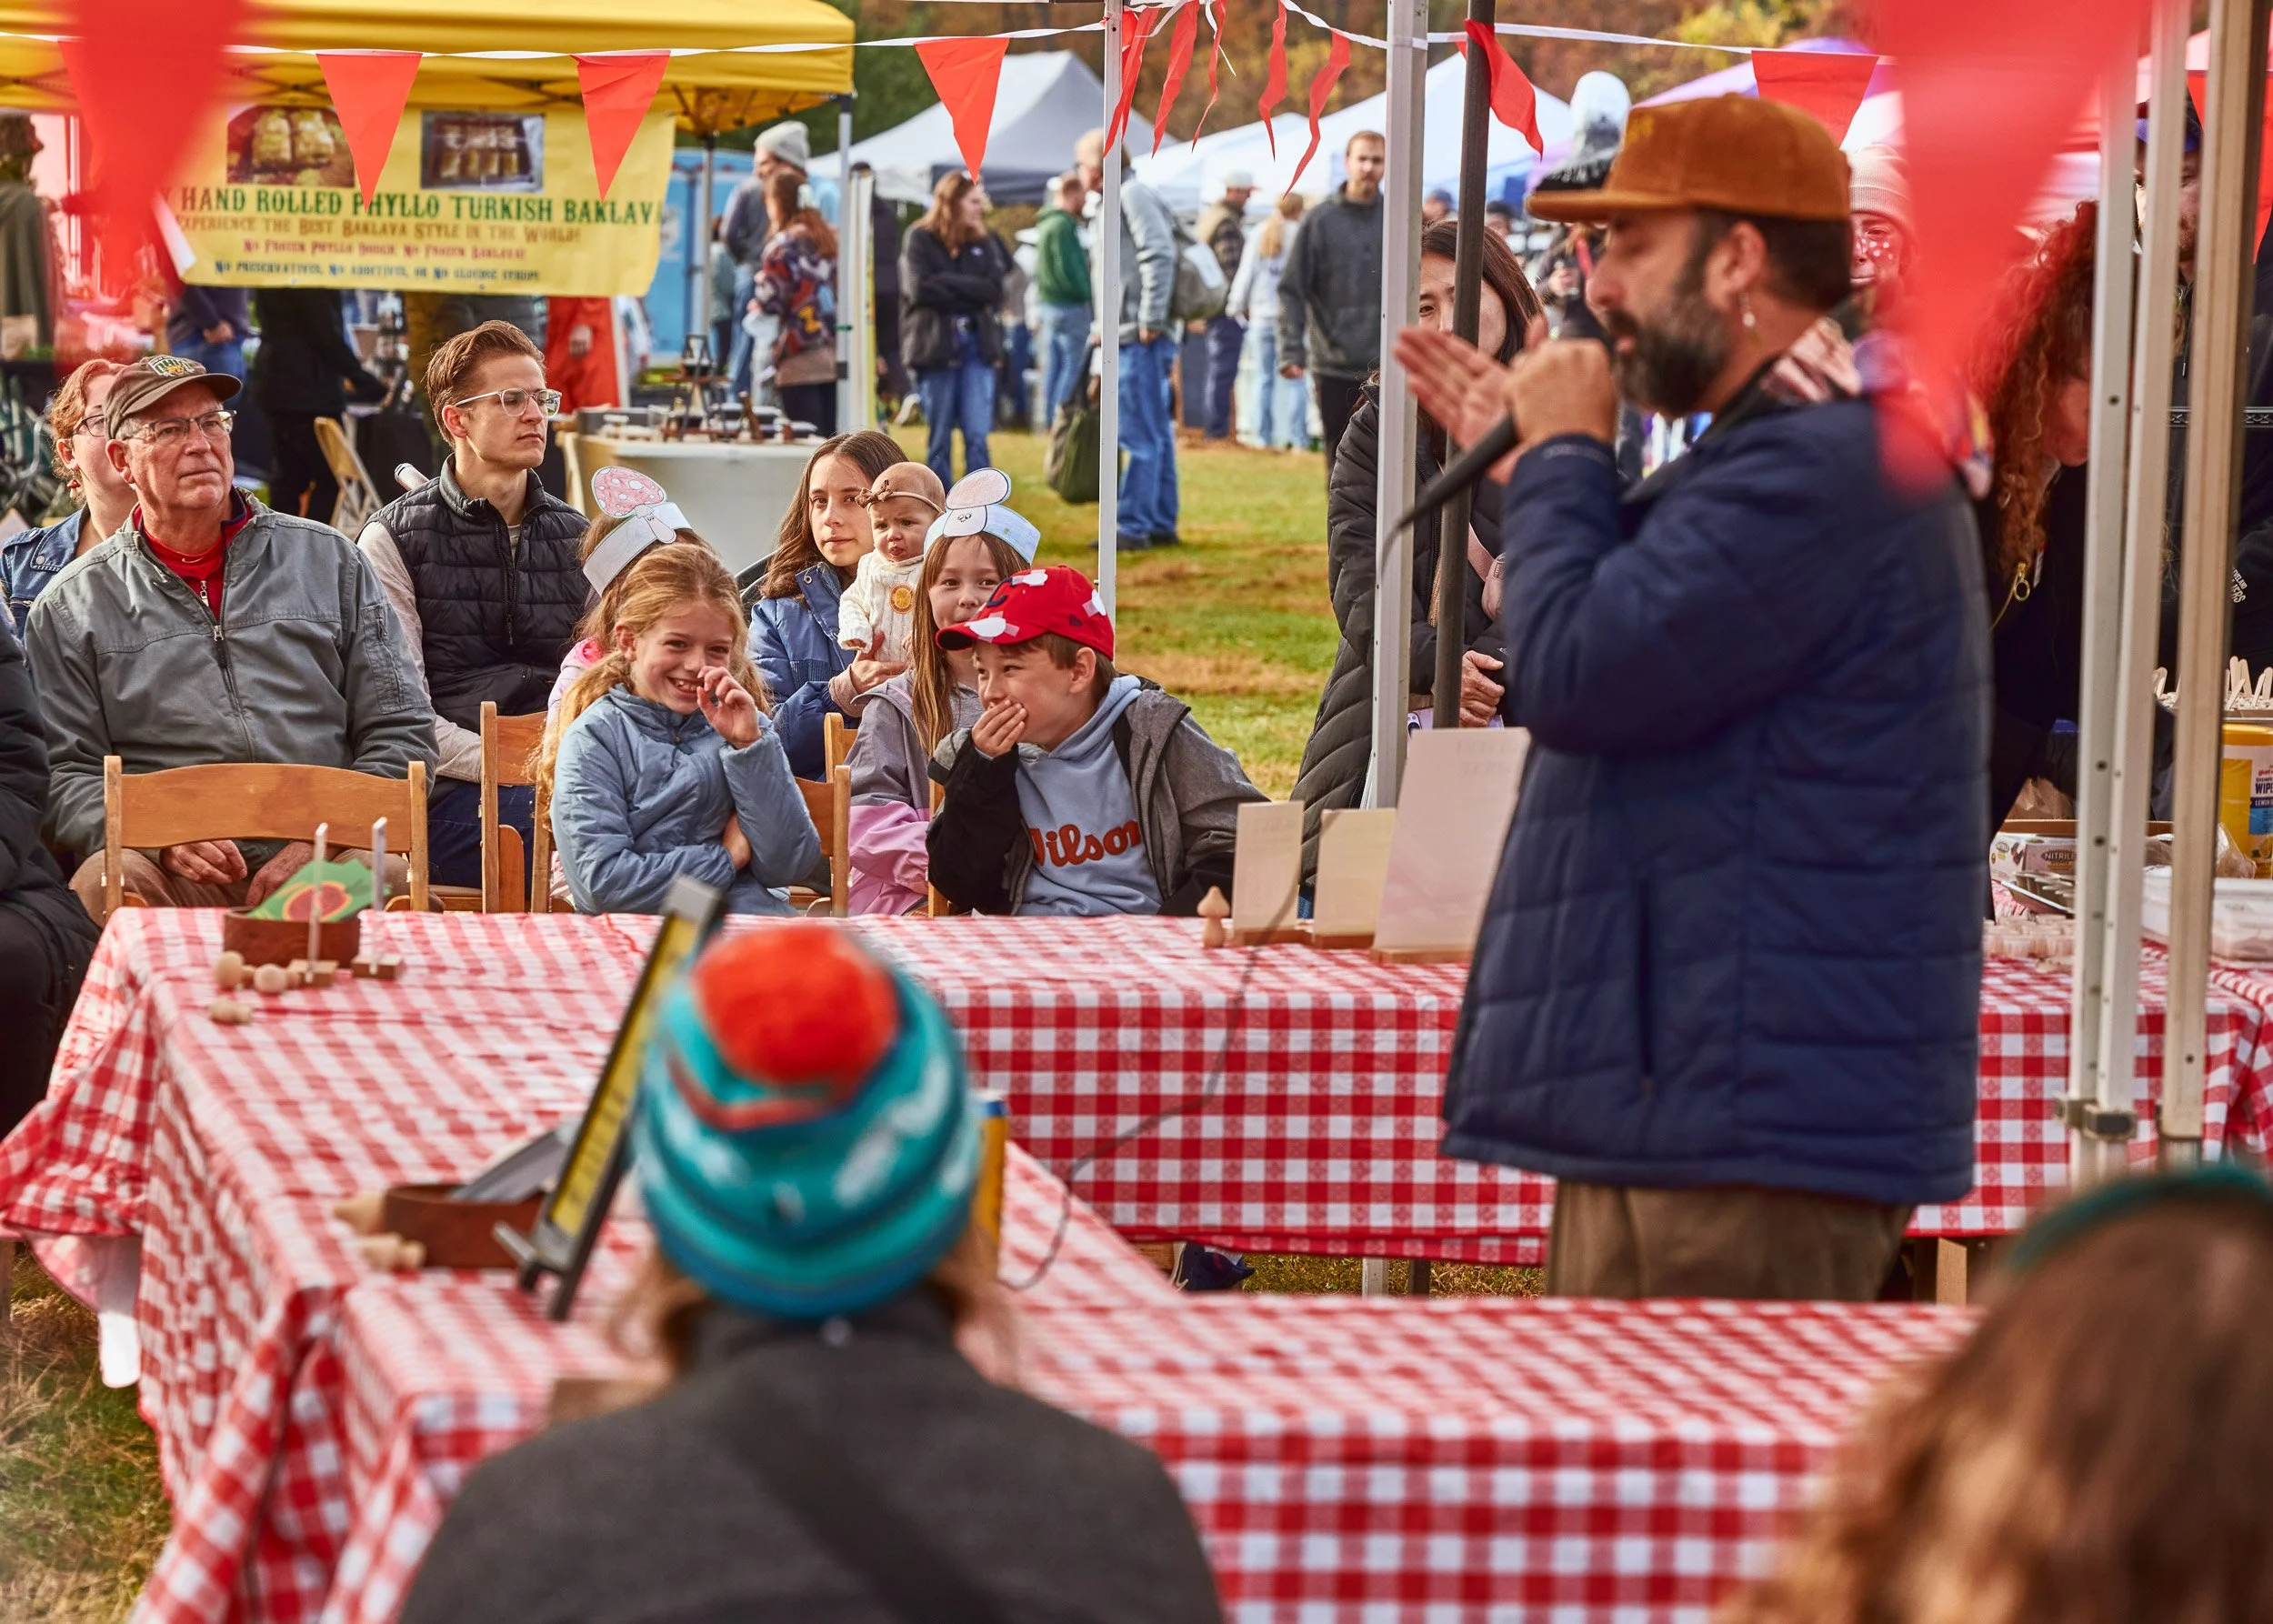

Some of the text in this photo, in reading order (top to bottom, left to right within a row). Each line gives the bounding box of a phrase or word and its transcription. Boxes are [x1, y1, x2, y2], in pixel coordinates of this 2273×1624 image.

[181, 186, 246, 212] HAND
[256, 188, 343, 216] ROLLED
[352, 192, 440, 219] PHYLLO
[449, 194, 553, 223] TURKISH
[261, 217, 291, 233] THE
[299, 218, 334, 236] BEST
[342, 219, 407, 237] BAKLAVA
[414, 222, 458, 240] STYLE
[466, 225, 481, 239] IN
[489, 226, 516, 240] THE
